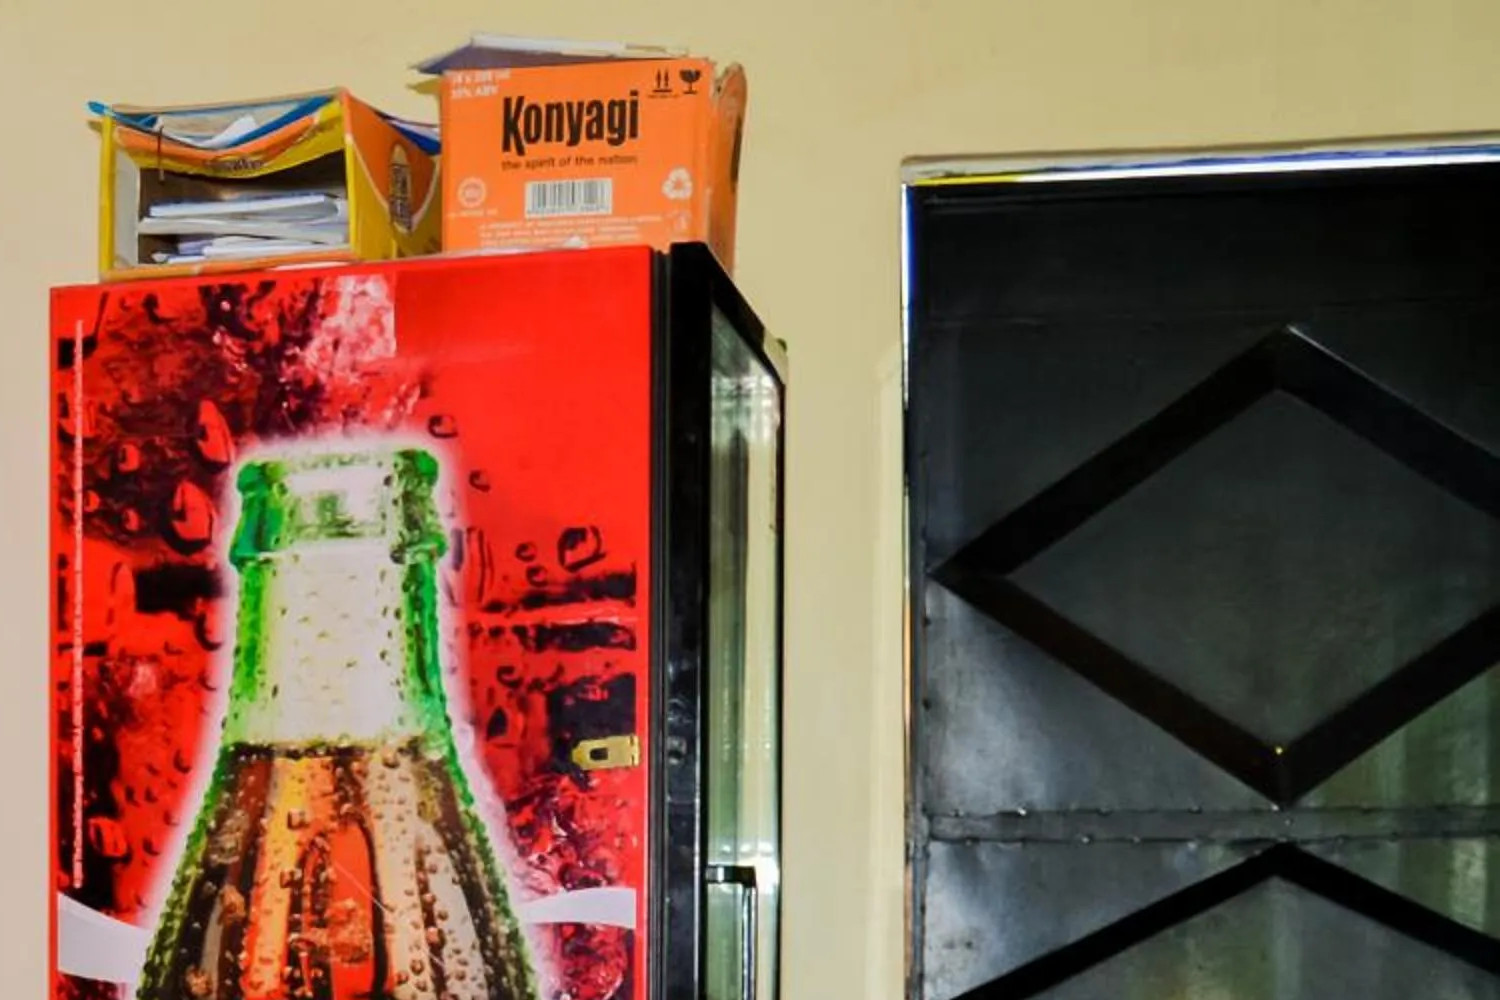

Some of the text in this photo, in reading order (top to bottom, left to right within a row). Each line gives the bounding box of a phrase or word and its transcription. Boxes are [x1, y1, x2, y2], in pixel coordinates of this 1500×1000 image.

[502, 90, 639, 156] Konyagi
[525, 157, 556, 170] spirit
[559, 156, 571, 167] of
[575, 155, 595, 166] the
